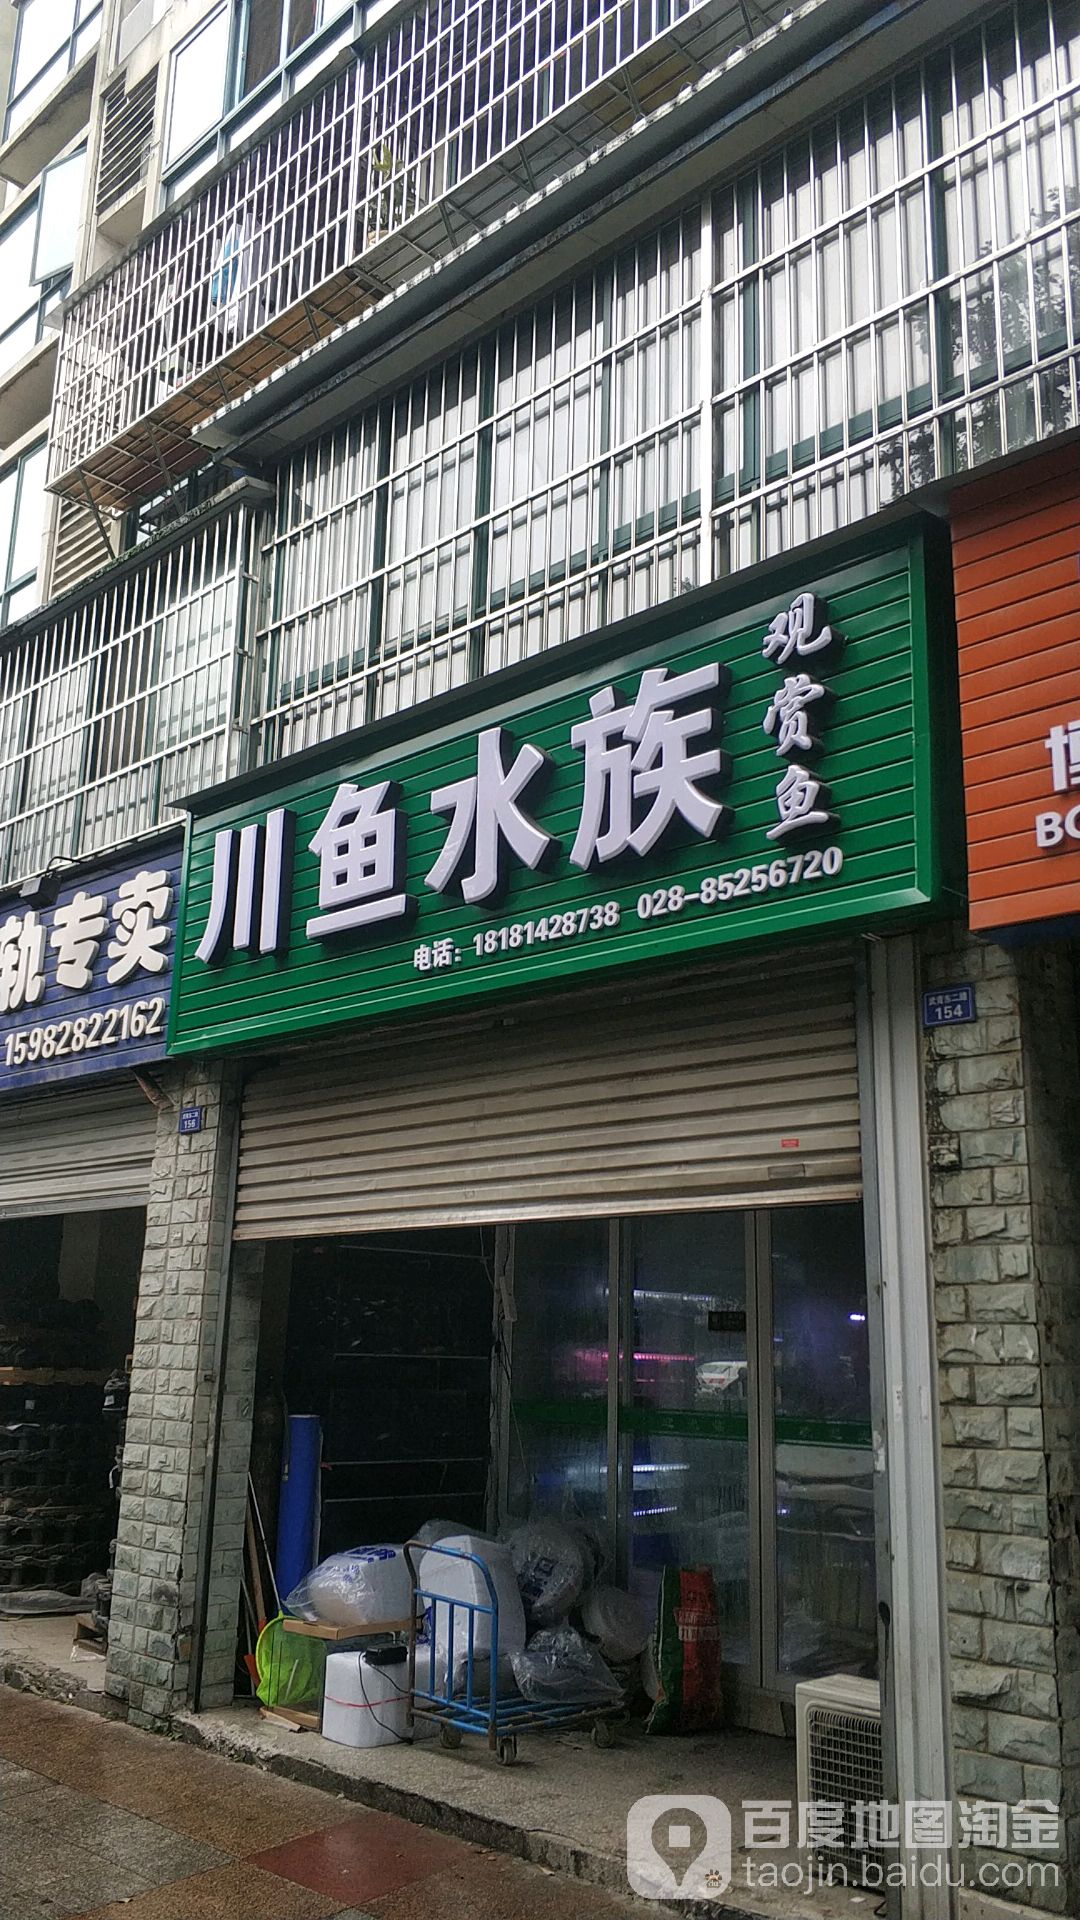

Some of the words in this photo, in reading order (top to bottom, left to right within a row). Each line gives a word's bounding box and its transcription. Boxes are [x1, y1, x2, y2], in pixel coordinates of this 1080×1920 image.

[763, 592, 832, 841] 观赏鱼
[195, 662, 723, 964] 川鱼水族
[472, 900, 620, 957] 18181428738
[637, 845, 843, 920] 028-85256720
[5, 997, 166, 1066] 15982822162
[934, 1003, 963, 1020] 154
[184, 1118, 196, 1129] 156
